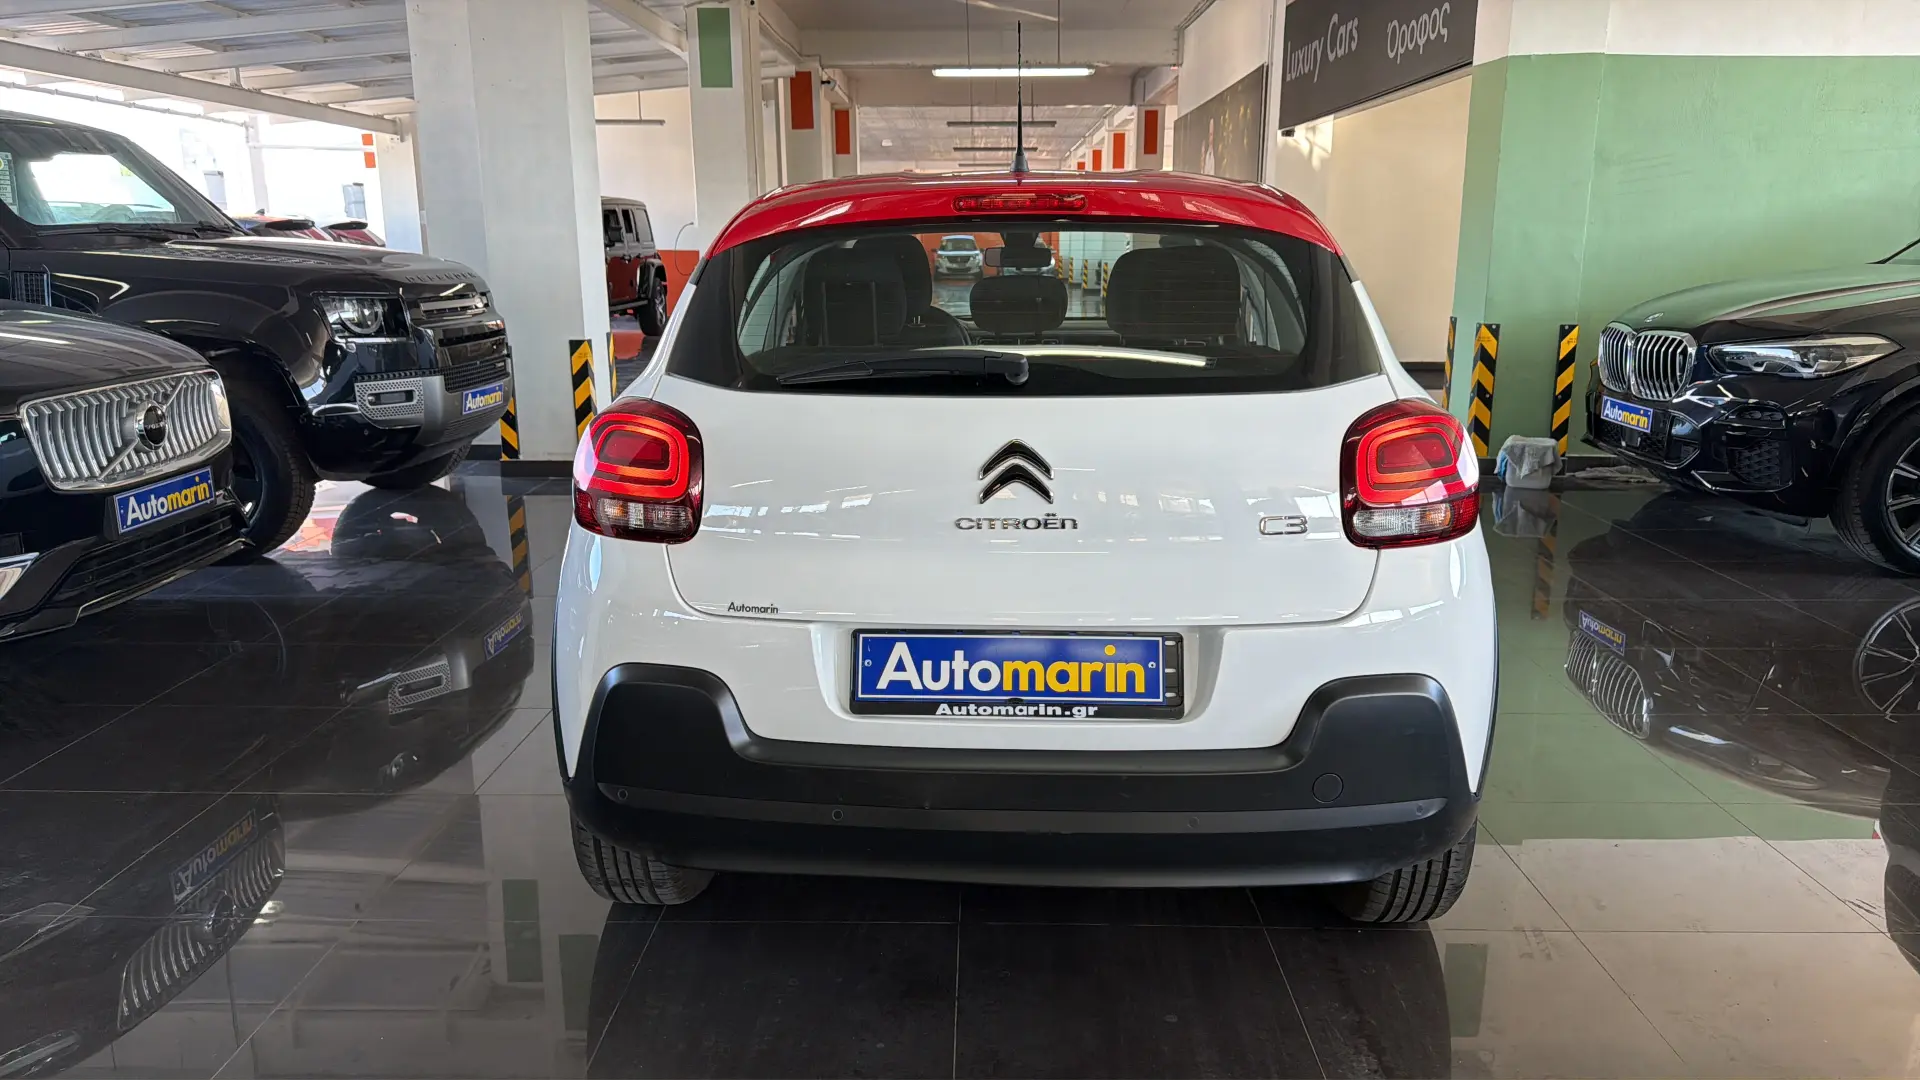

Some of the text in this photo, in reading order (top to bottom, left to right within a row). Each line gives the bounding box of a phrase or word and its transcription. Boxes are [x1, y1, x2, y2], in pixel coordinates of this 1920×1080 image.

[1286, 13, 1359, 83] Luxury Cars
[466, 386, 503, 411] Automarin
[1604, 400, 1648, 428] Automarin
[127, 476, 210, 525] Automarin
[1260, 515, 1307, 535] C3
[727, 601, 779, 614] Automarin
[876, 641, 1146, 693] Automarin
[935, 703, 1098, 718] Automarin.gr
